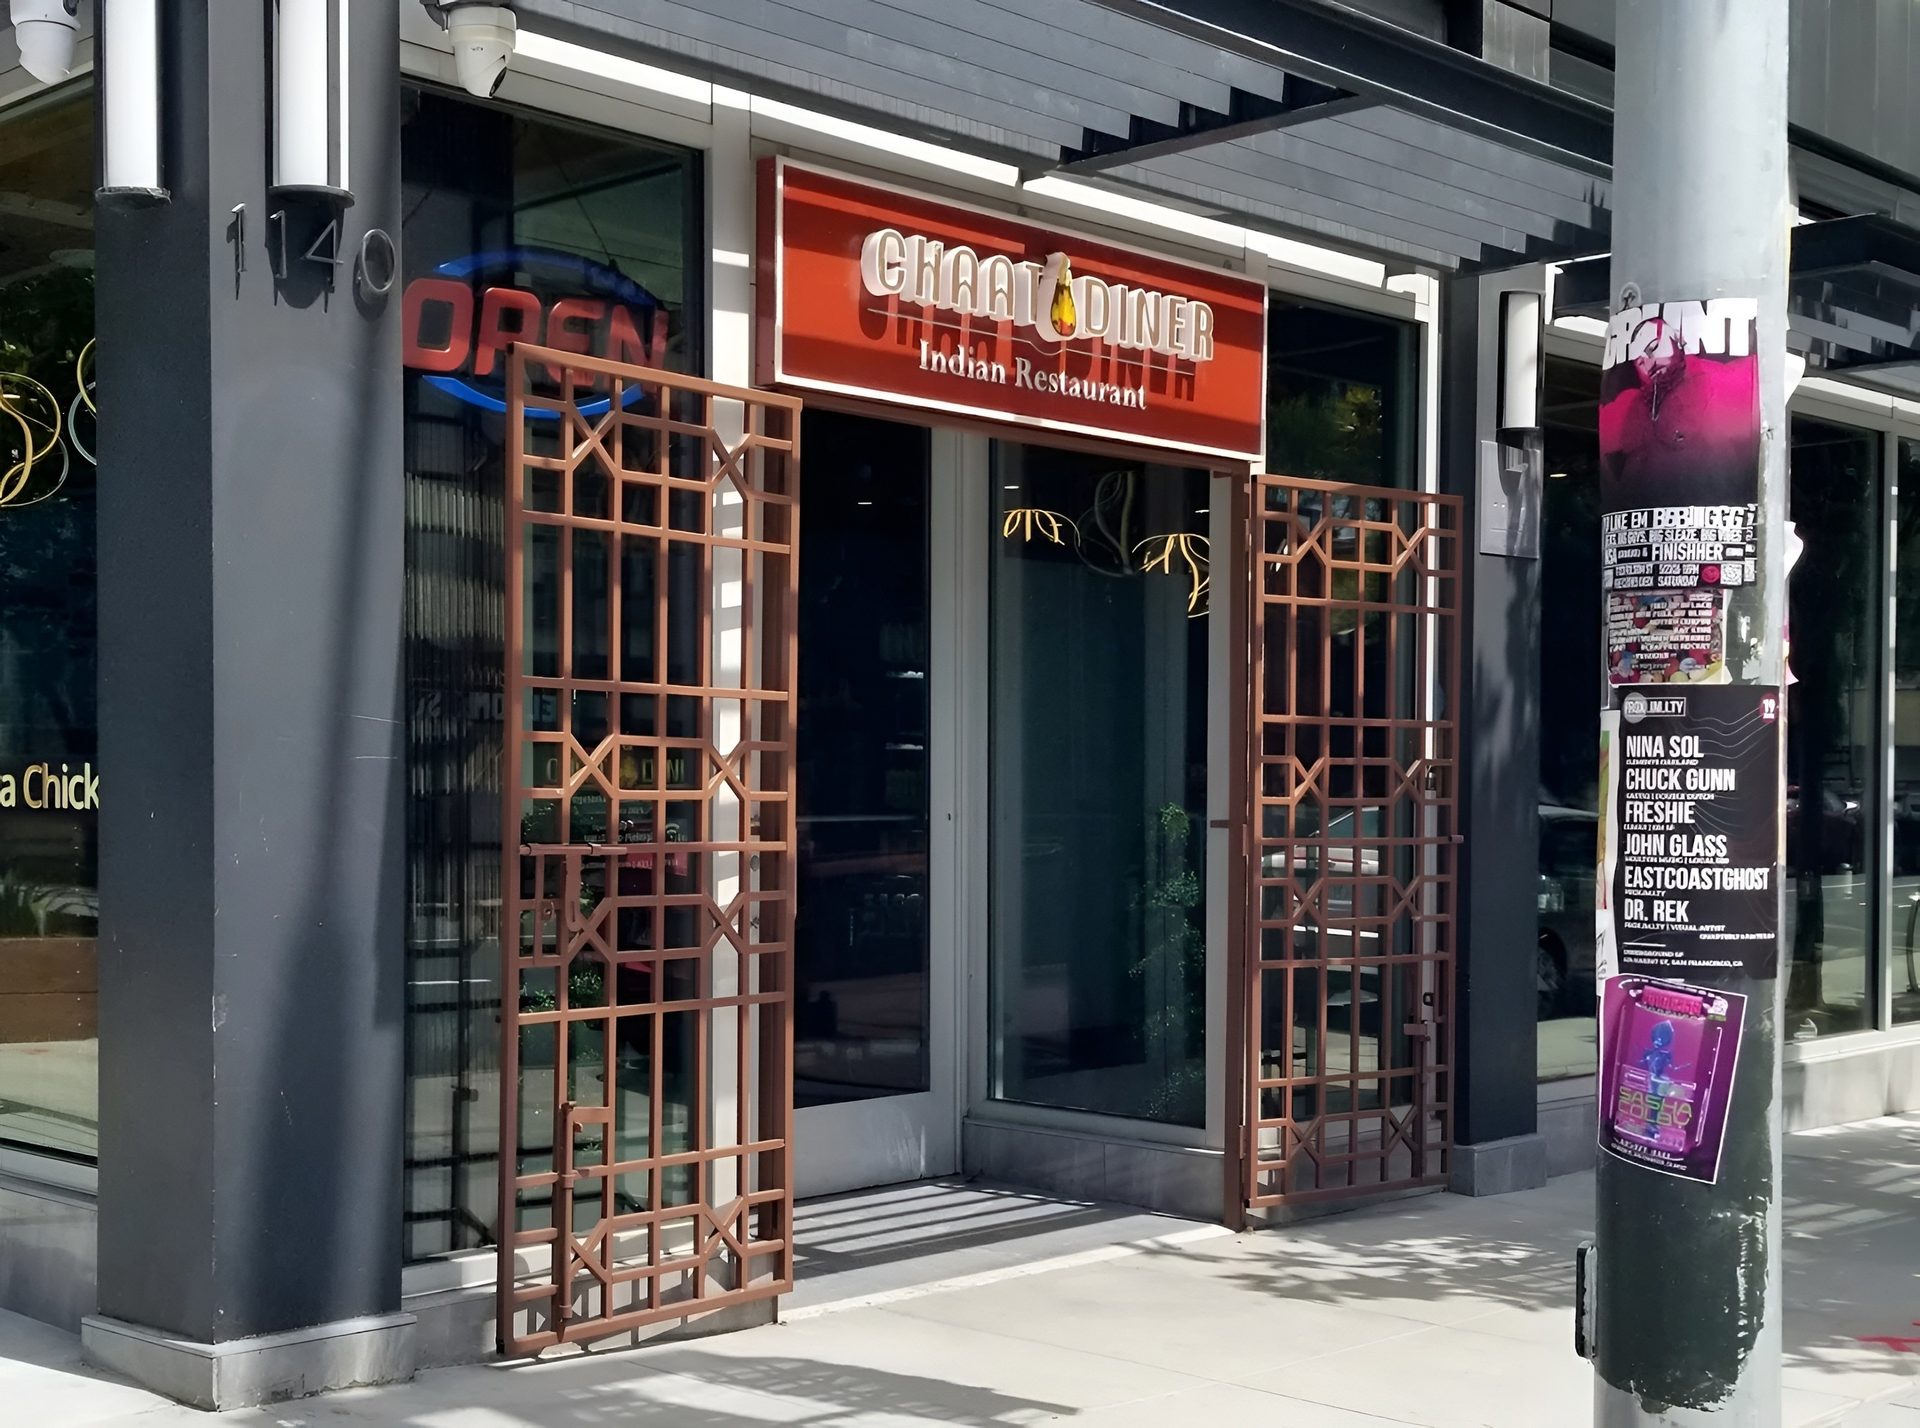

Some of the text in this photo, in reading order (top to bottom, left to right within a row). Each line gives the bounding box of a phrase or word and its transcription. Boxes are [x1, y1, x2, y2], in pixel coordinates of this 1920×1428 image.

[231, 203, 396, 293] 1140
[1073, 275, 1214, 362] DINER
[402, 278, 669, 395] OPEN
[919, 338, 1148, 410] Indian Restaurant
[1652, 543, 1724, 562] FINISHHER
[1626, 735, 1704, 758] NINA SOL
[1626, 768, 1736, 791] CHUCK GUNN
[1625, 801, 1695, 824] FRESHIE
[1624, 833, 1727, 857] JOHN GLASS
[1624, 866, 1770, 890] EASTCOASTGHOST
[1624, 899, 1689, 923] DR. REK
[1619, 1086, 1692, 1119] SASHA
